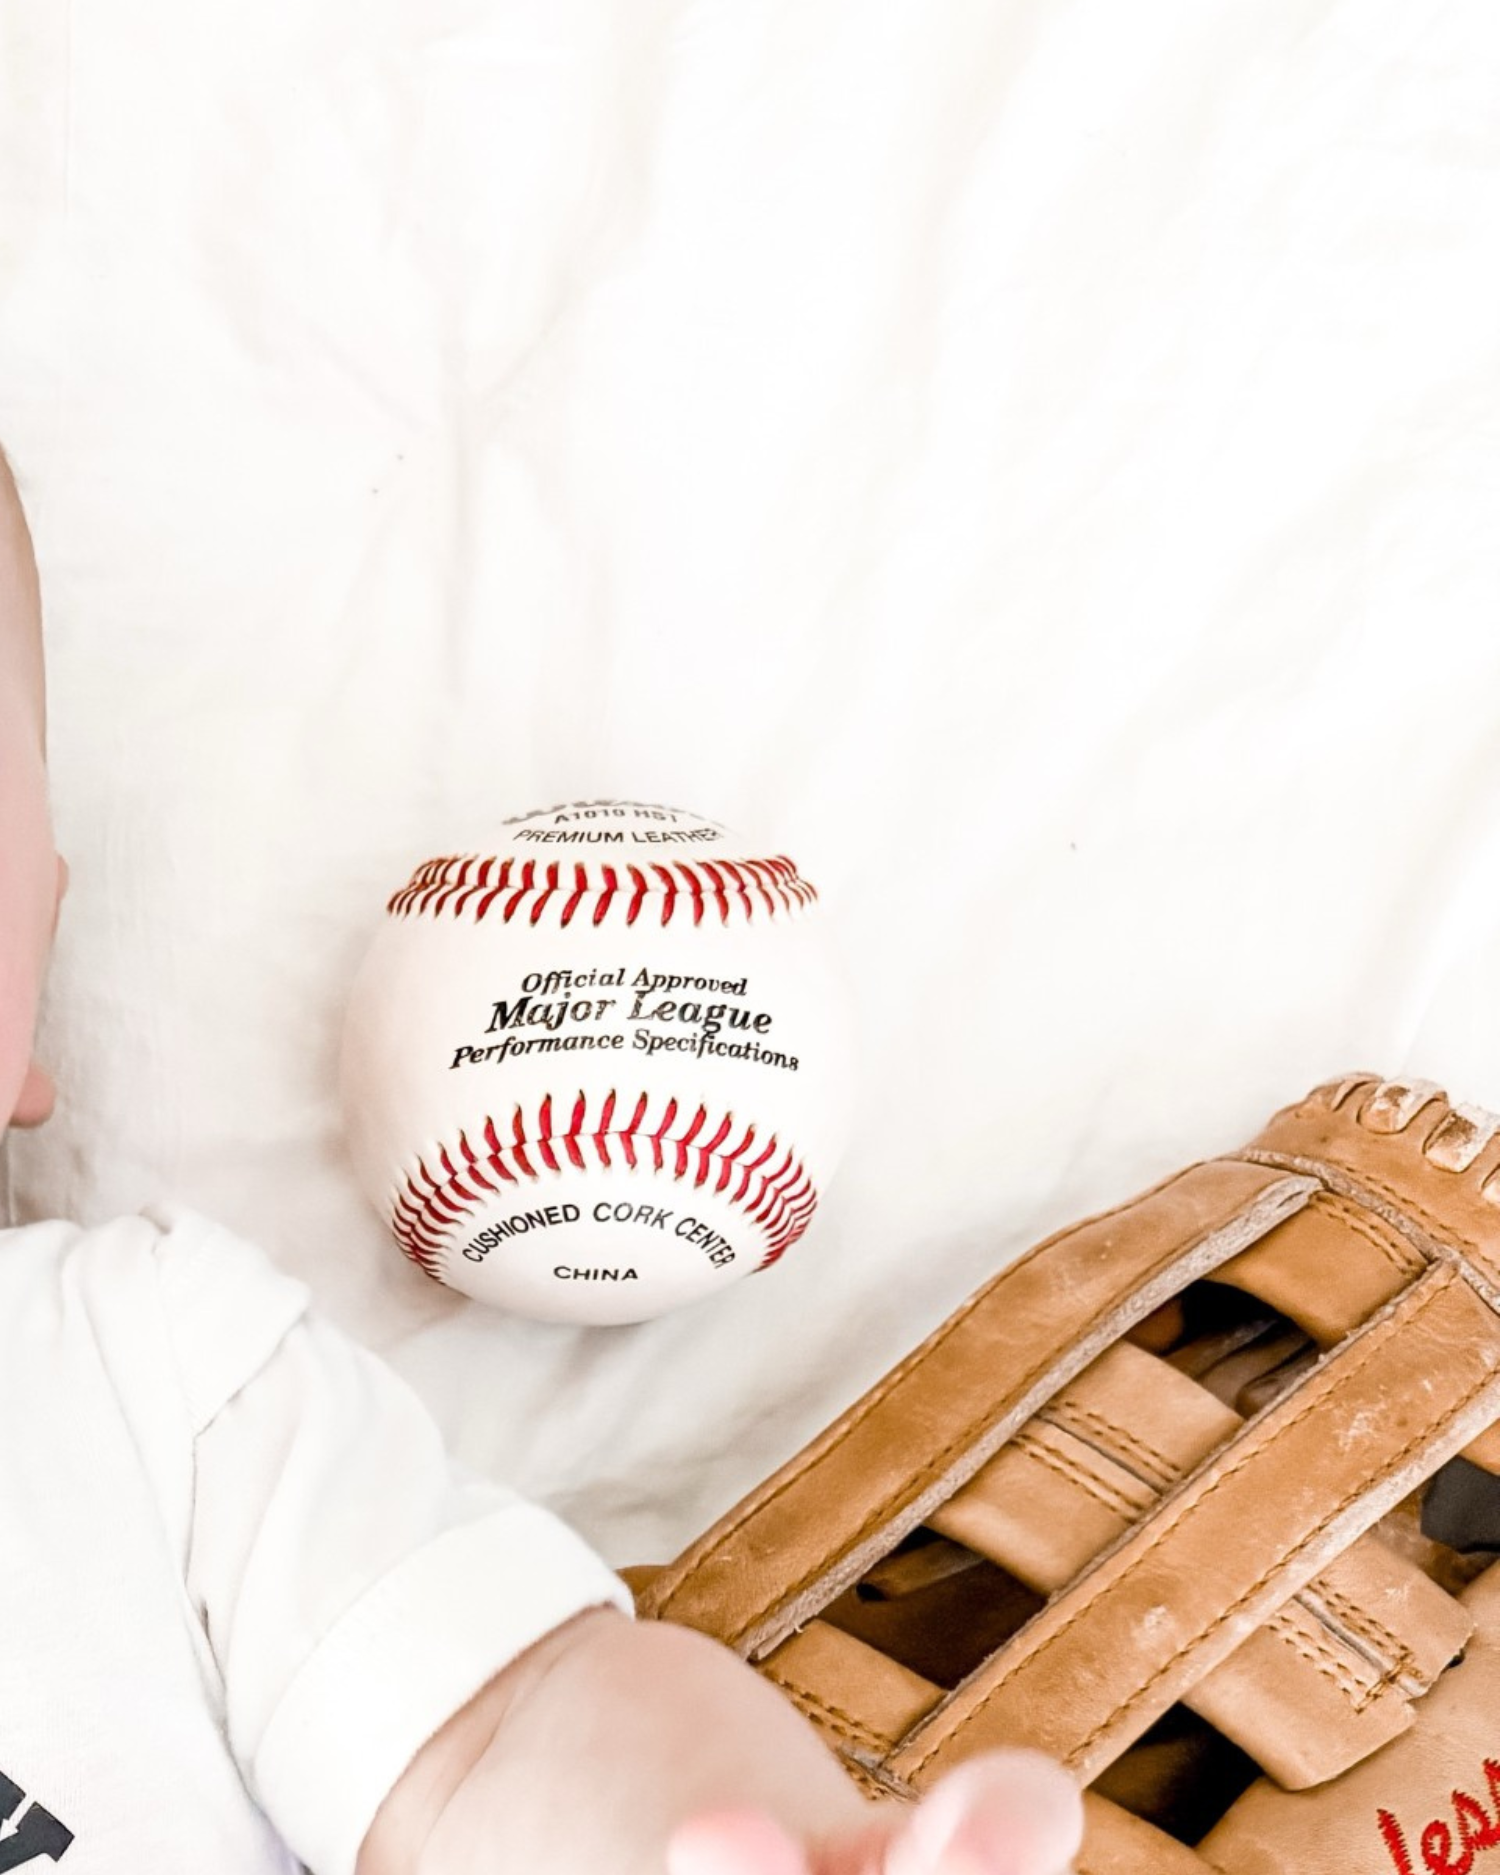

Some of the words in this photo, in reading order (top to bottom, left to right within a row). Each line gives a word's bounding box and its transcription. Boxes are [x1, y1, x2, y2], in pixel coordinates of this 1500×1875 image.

[513, 828, 624, 843] PREMIUM
[520, 967, 626, 999] Official
[631, 967, 748, 996] Approved
[484, 992, 617, 1034] Major
[626, 990, 773, 1037] League
[449, 1035, 625, 1070] Performance
[632, 1029, 799, 1071] Specifications
[462, 1203, 581, 1264] CUSHIONED
[593, 1202, 673, 1229] CORK
[674, 1216, 736, 1269] CENTER
[553, 1265, 639, 1281] CHINA
